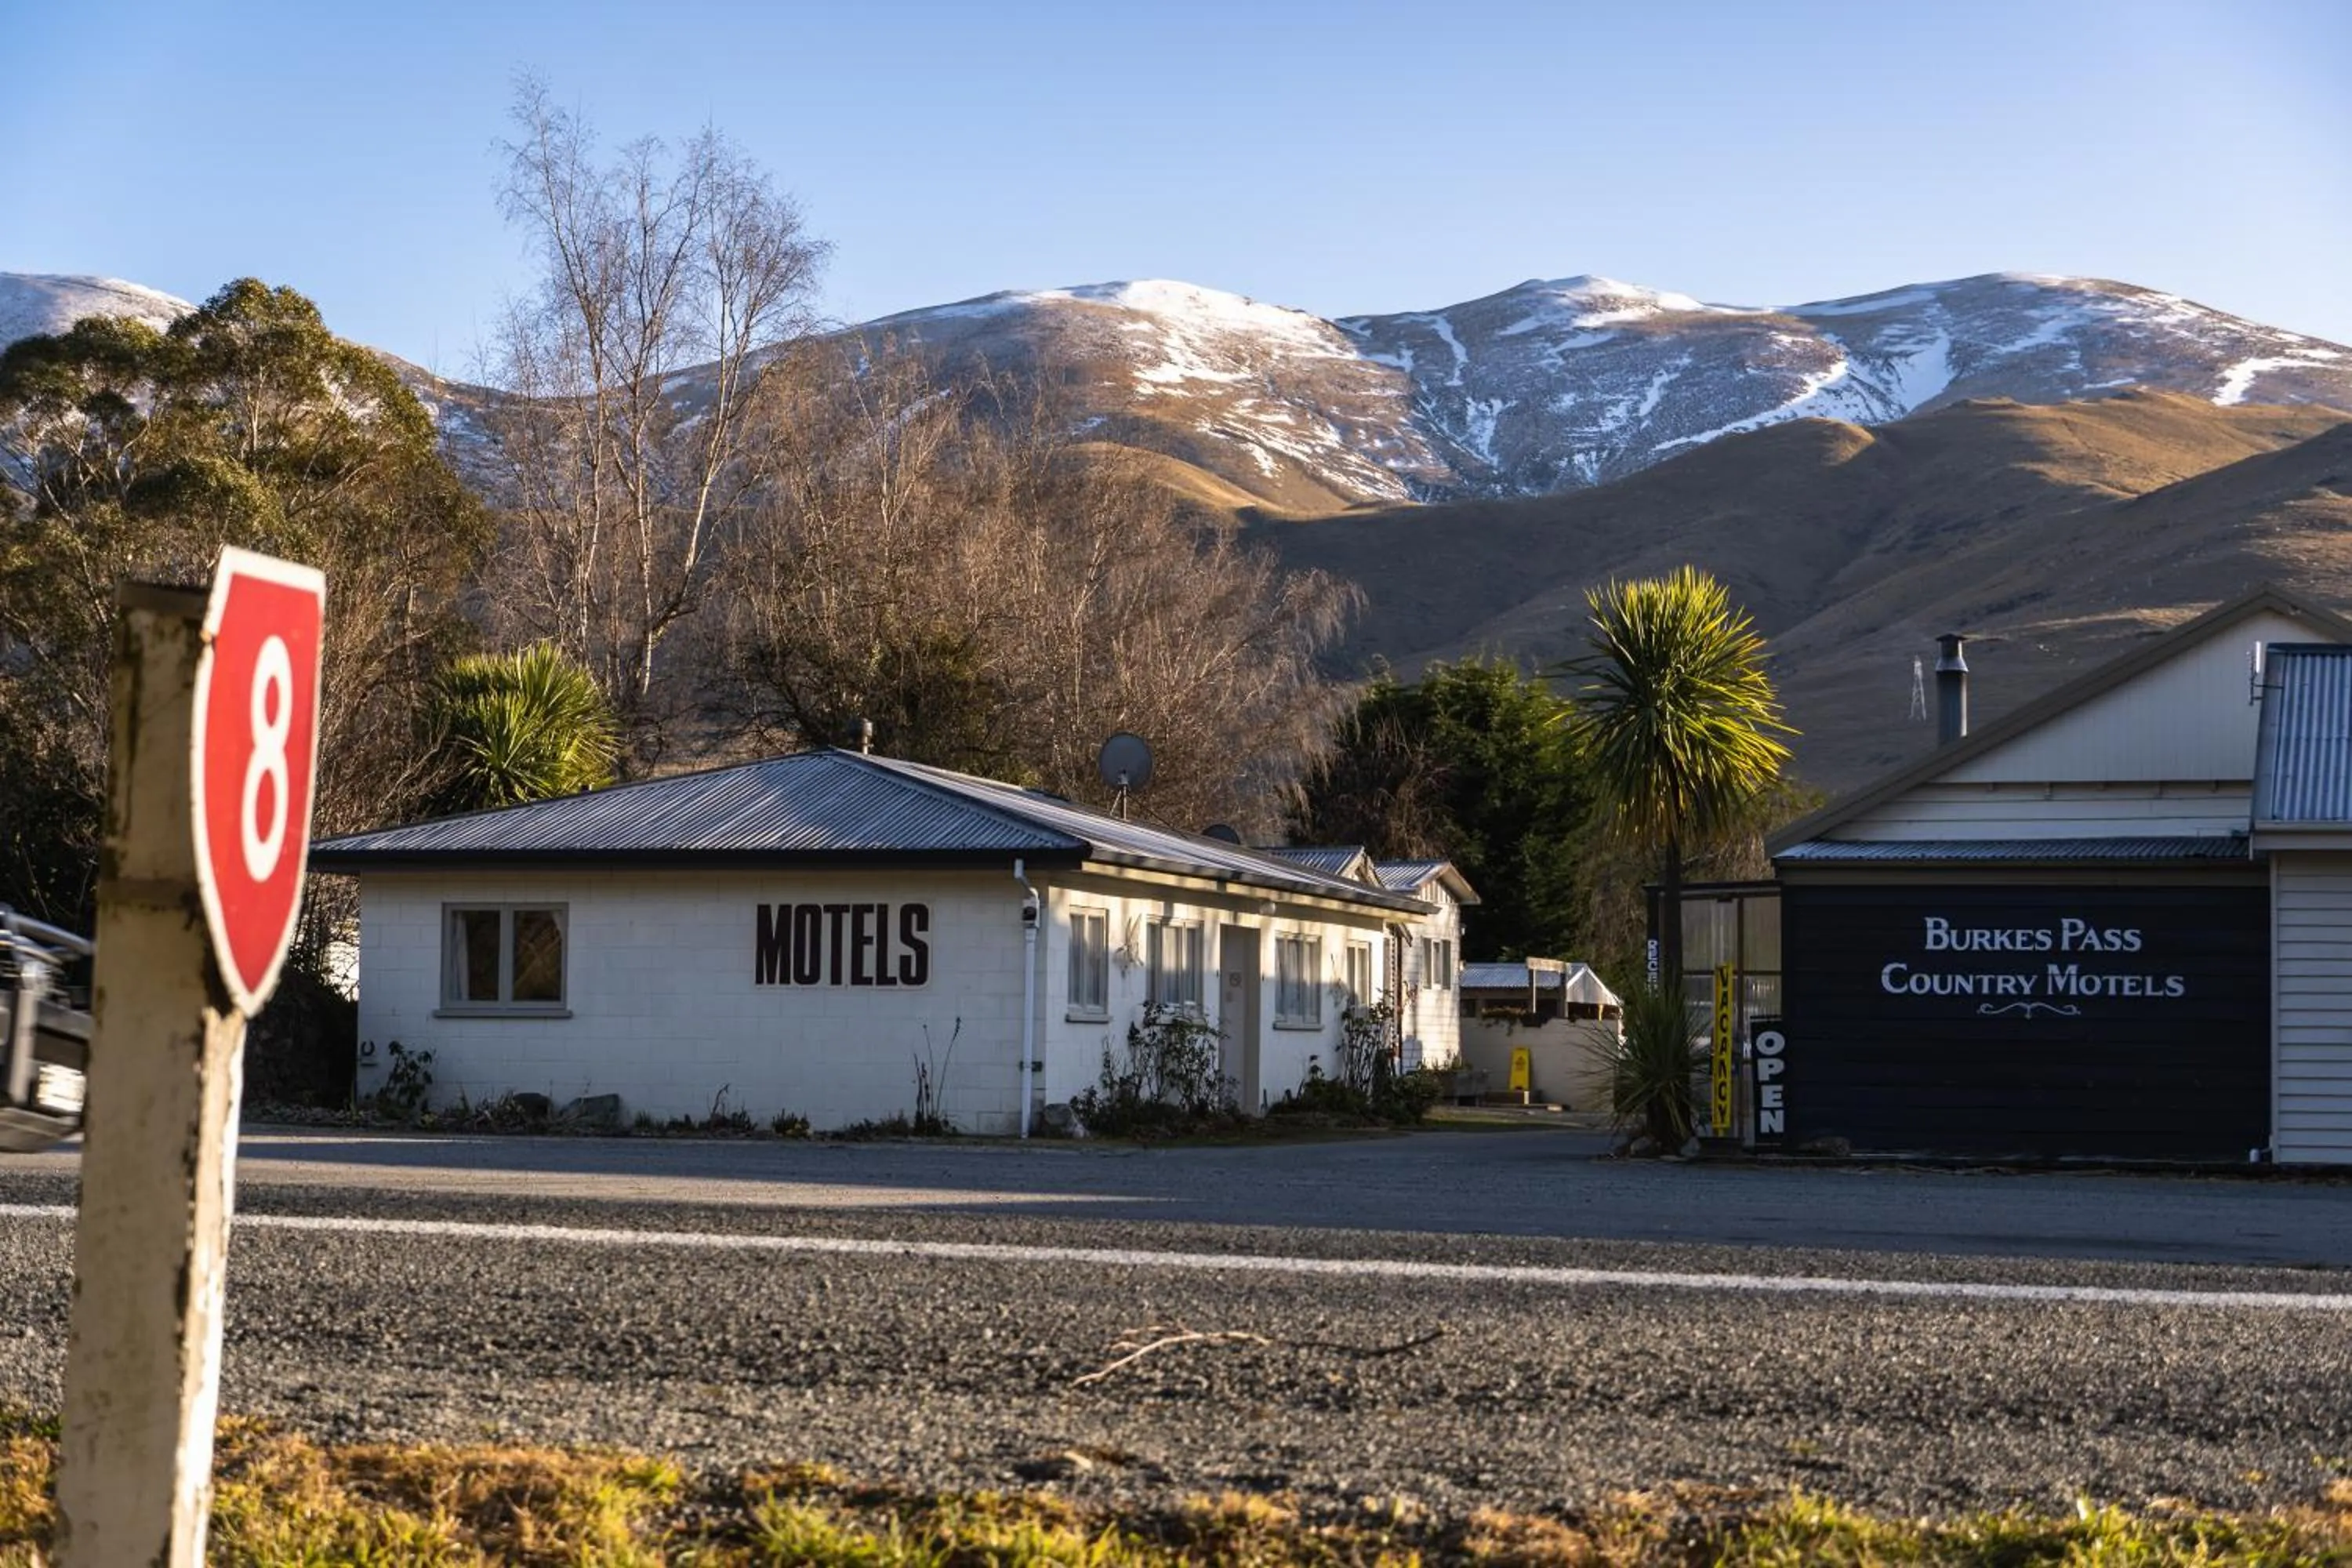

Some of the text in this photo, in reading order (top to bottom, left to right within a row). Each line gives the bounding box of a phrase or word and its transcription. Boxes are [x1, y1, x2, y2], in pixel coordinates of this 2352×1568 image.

[241, 634, 292, 883] 8
[755, 903, 928, 985] MOTELS
[1882, 963, 2185, 997] COUNTRY MOTELS
[1925, 917, 2142, 952] BURKES PASS
[1717, 967, 1730, 1124] VACANCY
[1755, 1031, 1785, 1133] OPEN
